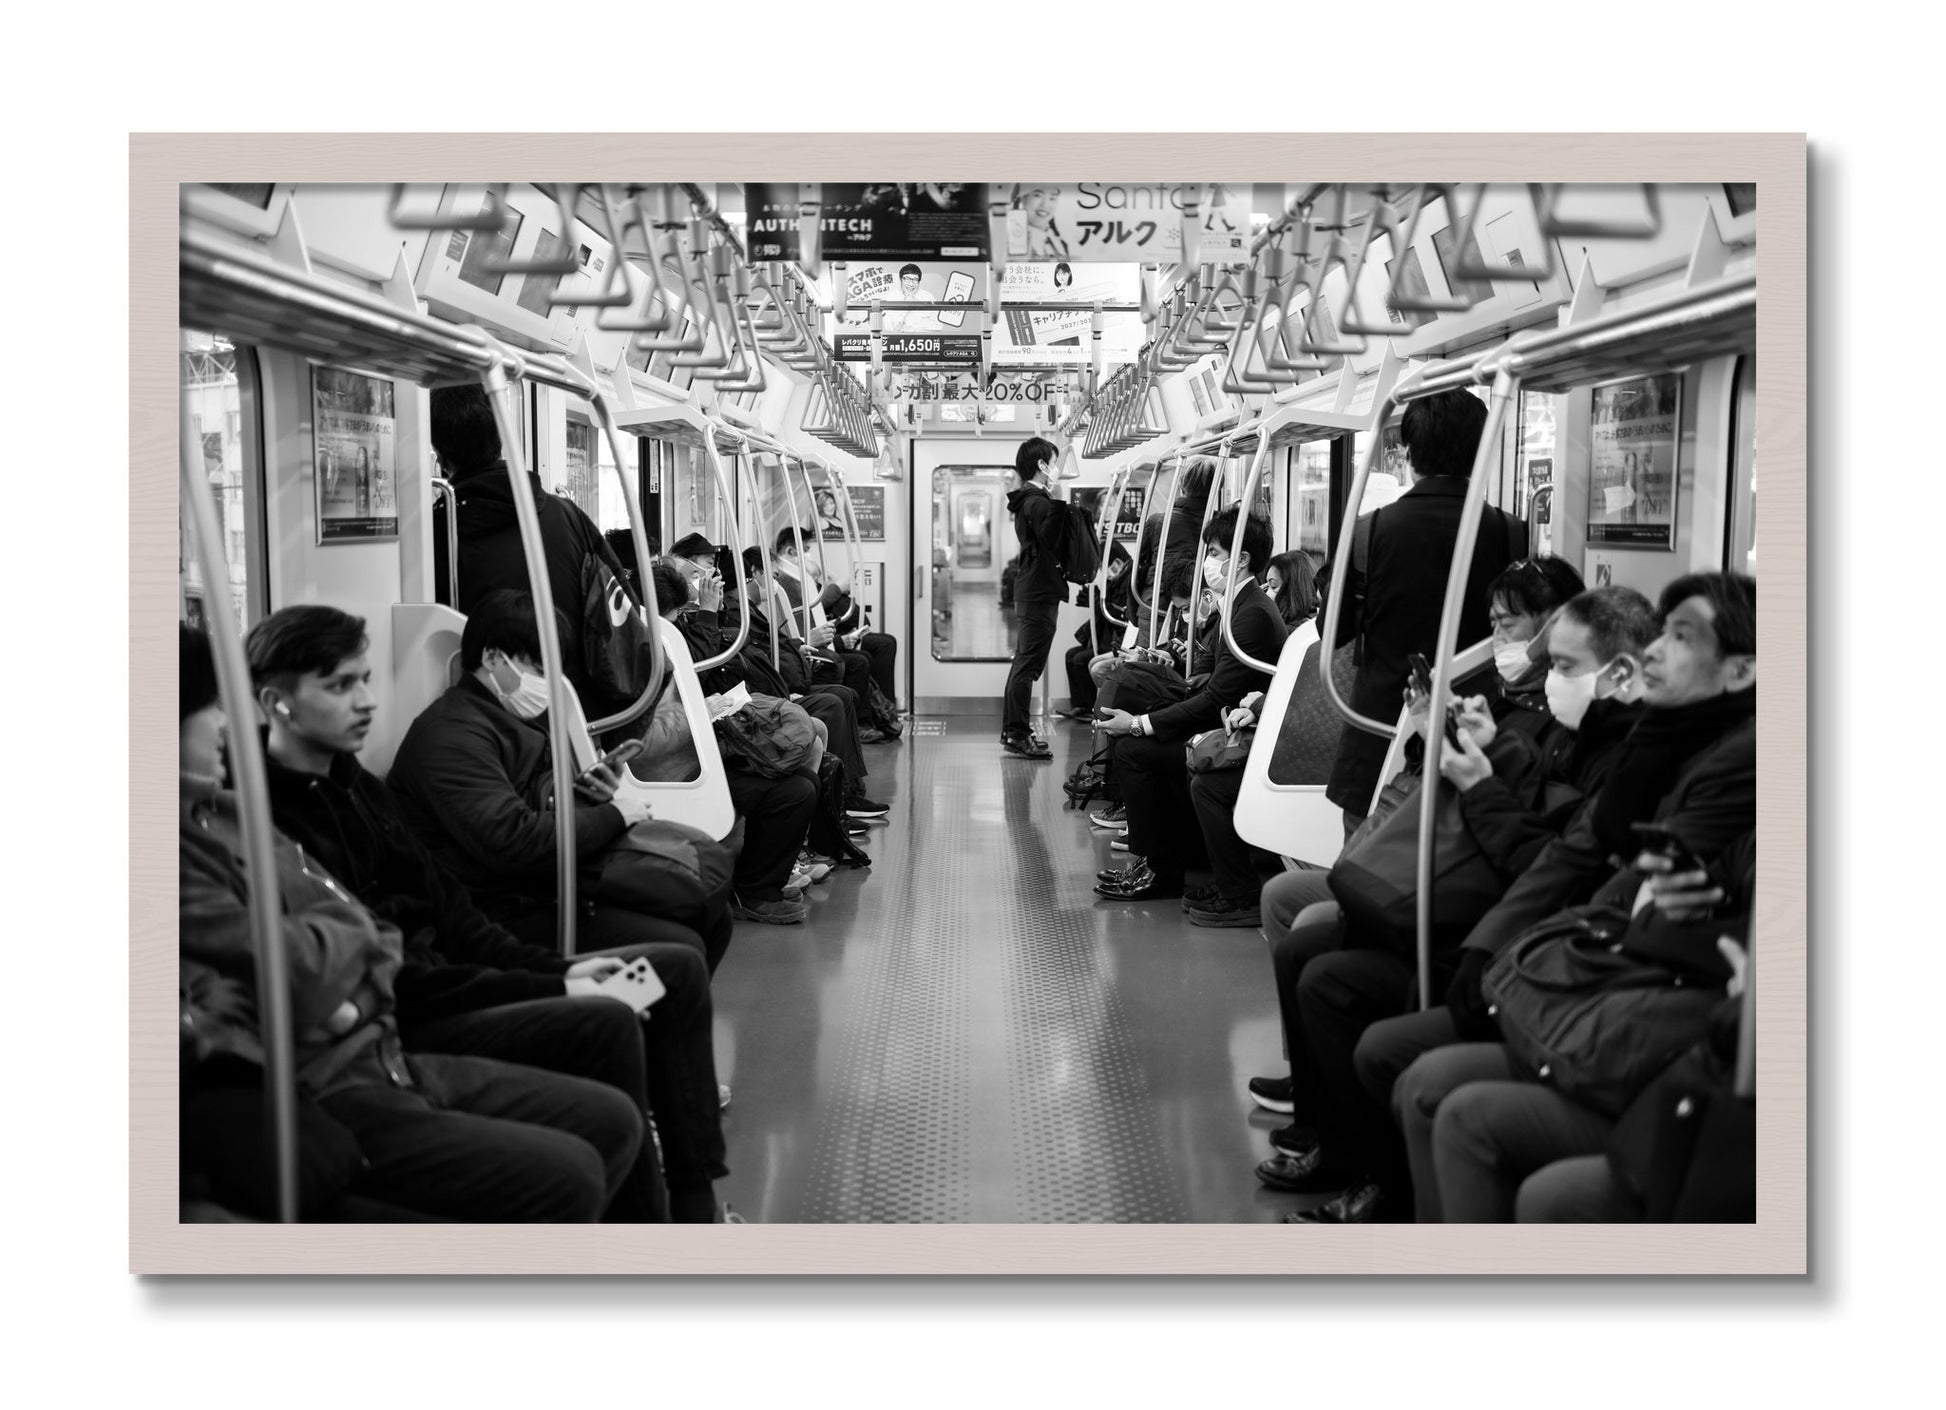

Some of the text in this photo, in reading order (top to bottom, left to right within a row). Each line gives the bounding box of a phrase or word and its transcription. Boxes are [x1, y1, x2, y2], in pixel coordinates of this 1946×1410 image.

[753, 218, 873, 232] AUTHTECH
[1076, 221, 1157, 246] アルク
